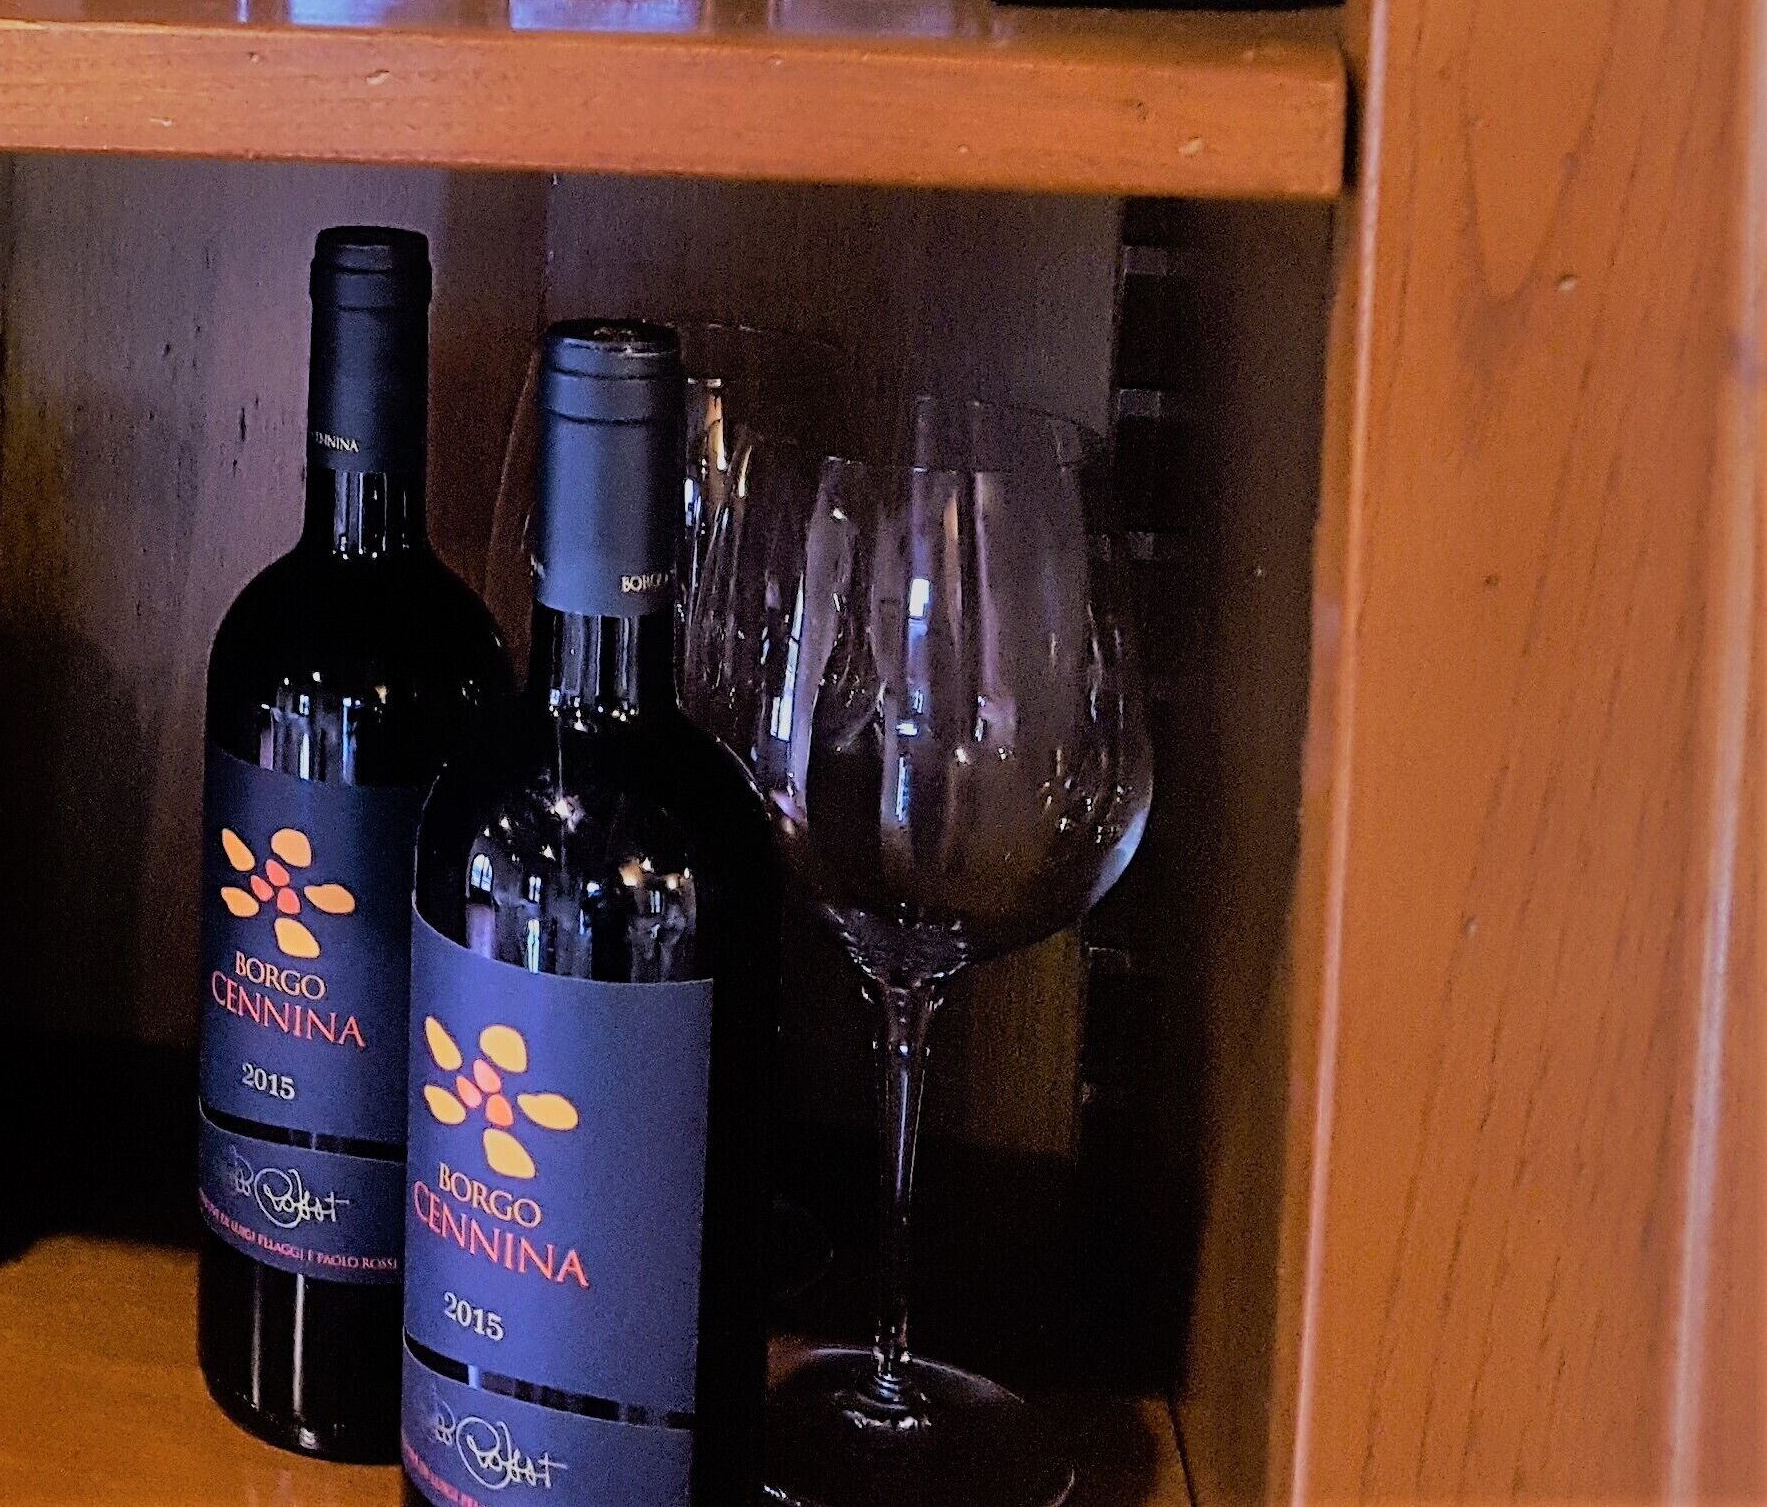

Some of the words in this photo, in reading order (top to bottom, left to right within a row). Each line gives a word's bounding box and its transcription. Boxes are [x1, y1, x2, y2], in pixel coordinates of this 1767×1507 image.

[235, 950, 326, 1001] BORGO
[211, 970, 367, 1049] CENNINA
[241, 1061, 296, 1101] 2015
[437, 1161, 542, 1229] BORGO
[317, 1251, 359, 1269] PAOLO
[362, 1257, 397, 1269] ROSSI
[413, 1180, 590, 1289] CENNINA
[442, 1291, 505, 1342] 2015
